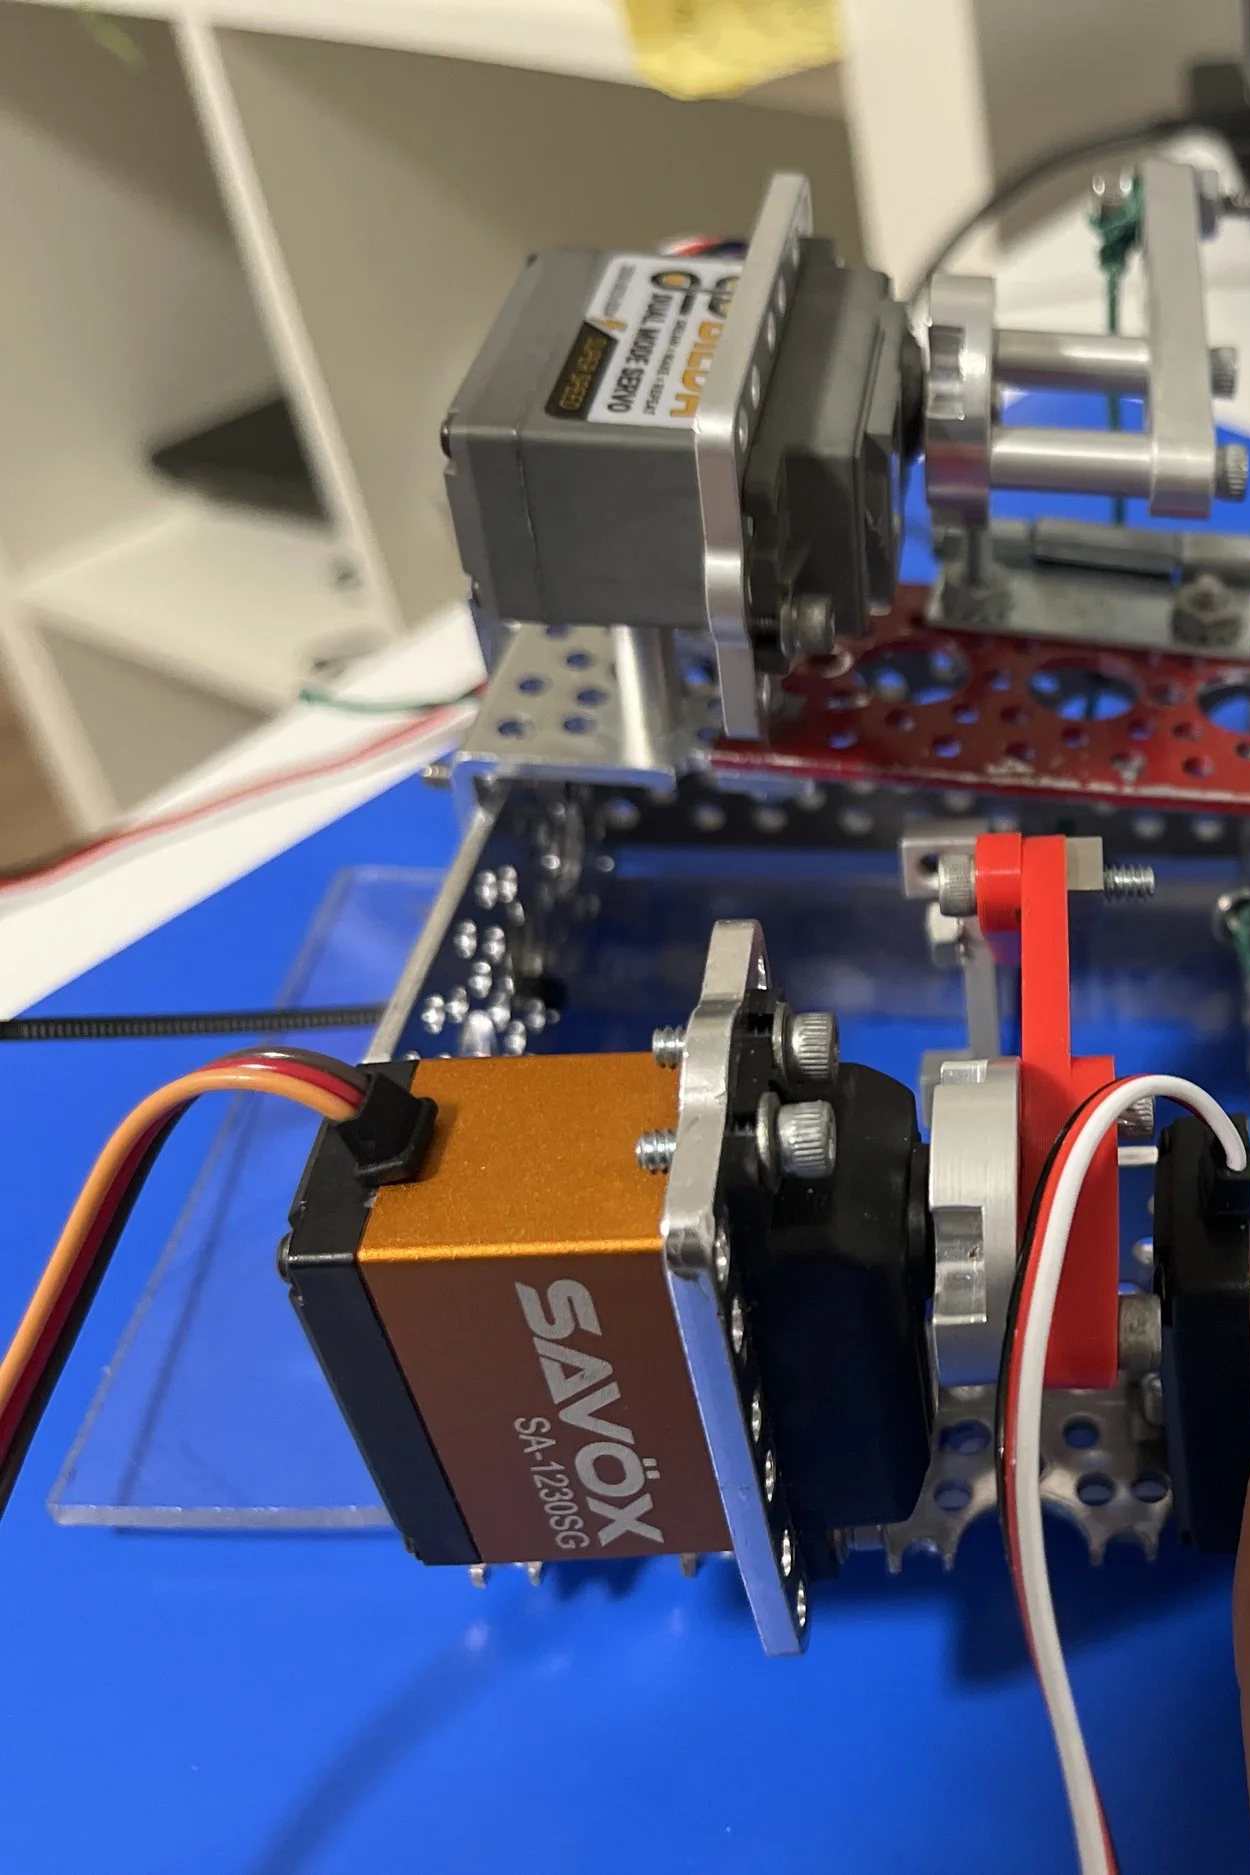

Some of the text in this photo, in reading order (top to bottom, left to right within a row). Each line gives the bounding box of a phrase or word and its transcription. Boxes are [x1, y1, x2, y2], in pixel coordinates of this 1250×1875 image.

[606, 293, 673, 414] DUAL MODE SERVO
[513, 1277, 665, 1549] SAVÖX
[513, 1416, 591, 1551] SA-1230SG
